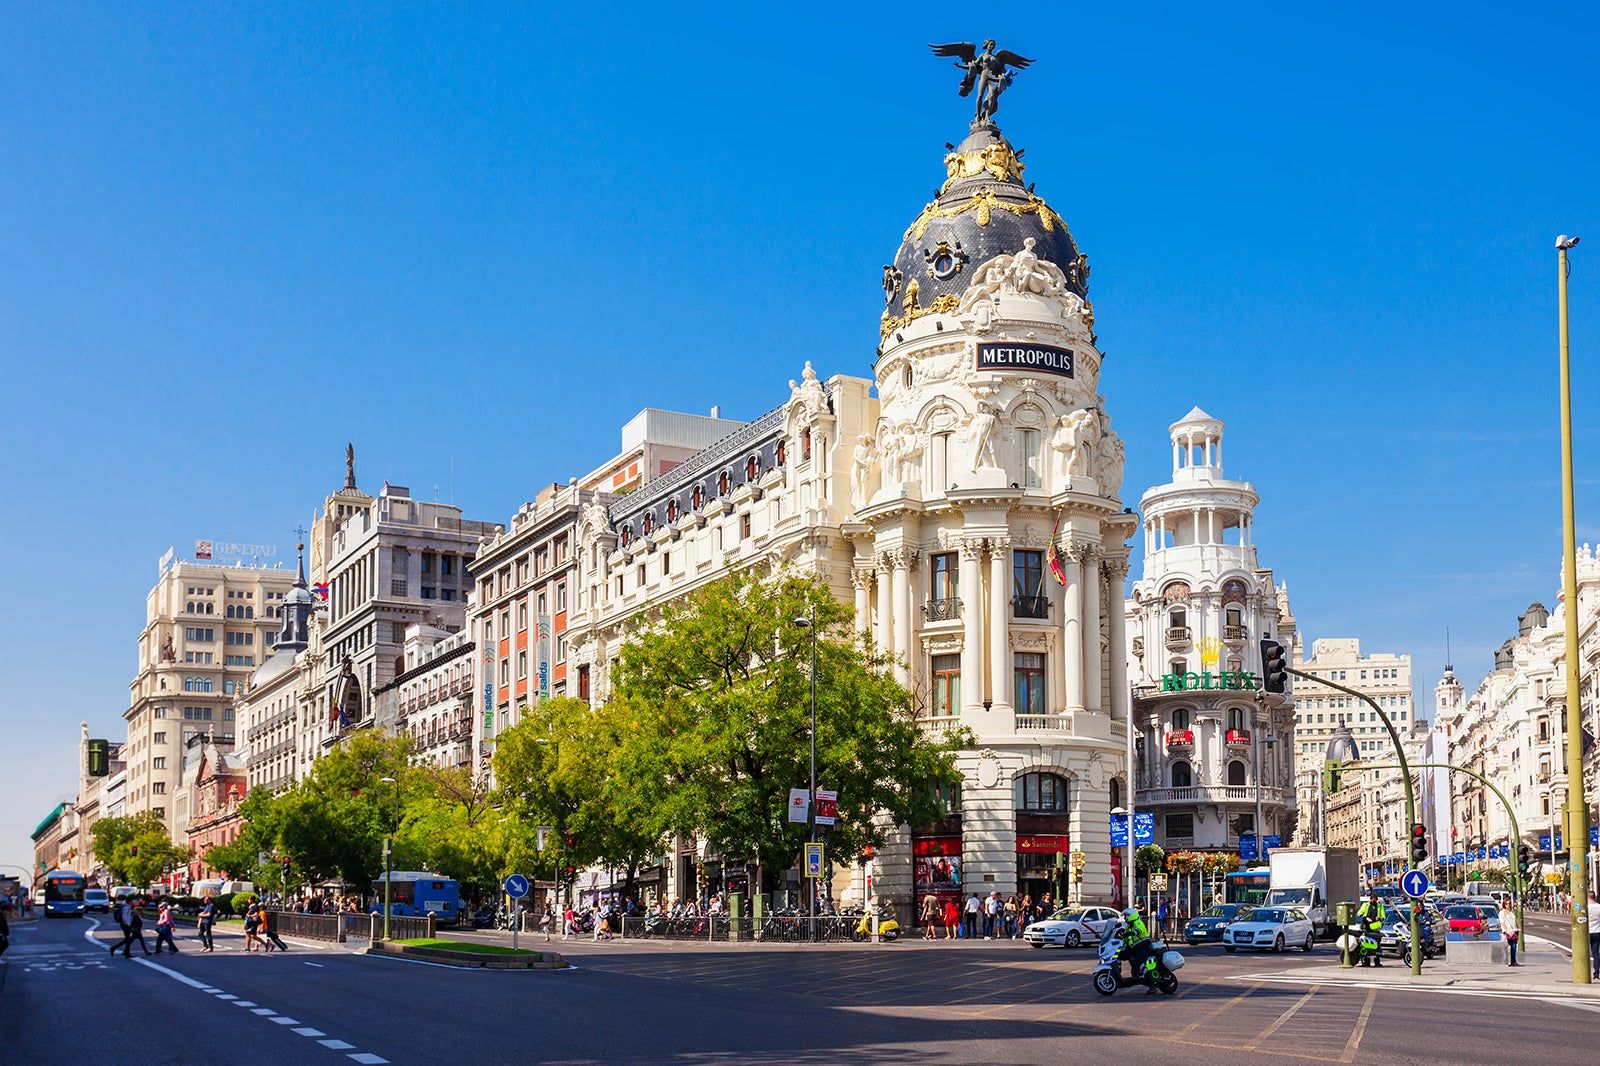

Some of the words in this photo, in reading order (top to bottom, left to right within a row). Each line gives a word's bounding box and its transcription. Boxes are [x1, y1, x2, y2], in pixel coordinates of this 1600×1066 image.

[983, 348, 1071, 370] METROPOLIS
[215, 542, 277, 557] GENERALI
[539, 661, 548, 690] salida
[1161, 671, 1257, 692] ROLEX
[484, 683, 493, 711] salida
[484, 711, 494, 729] hay
